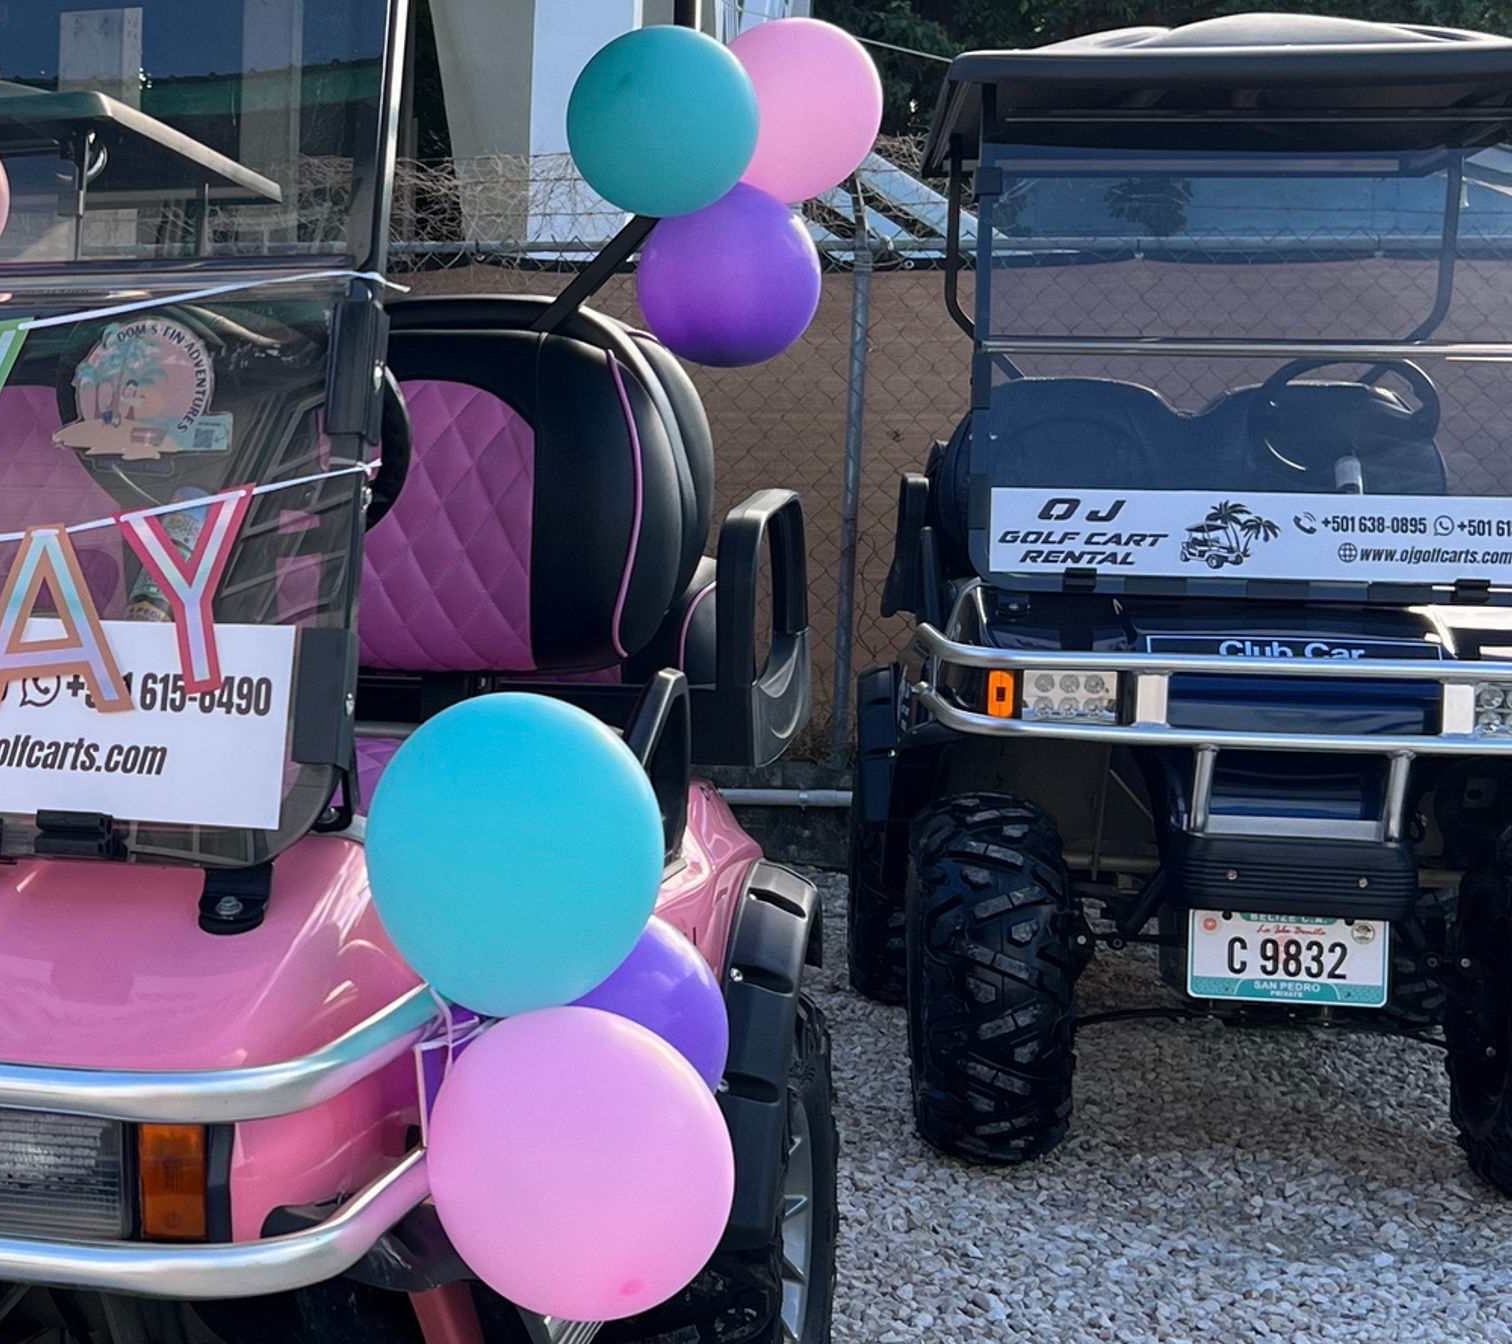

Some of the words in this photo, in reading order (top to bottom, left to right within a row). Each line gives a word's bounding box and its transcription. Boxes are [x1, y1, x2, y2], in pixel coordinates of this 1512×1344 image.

[163, 327, 185, 345] FIN
[177, 342, 206, 433] ADVENTURES
[1322, 516, 1355, 532] +501
[1359, 516, 1427, 534] 638-0895
[1457, 519, 1492, 536] +501
[998, 531, 1081, 545] GOLF
[1084, 532, 1169, 547] CART
[1019, 550, 1135, 565] RENTAL
[1360, 547, 1512, 564] www.ojgolfcarts.com
[1219, 640, 1292, 657] Club
[1304, 643, 1365, 659] Car
[1227, 936, 1247, 974] C
[1260, 938, 1348, 979] 9832
[1254, 980, 1277, 990] SAN
[1279, 981, 1321, 992] PEDRO
